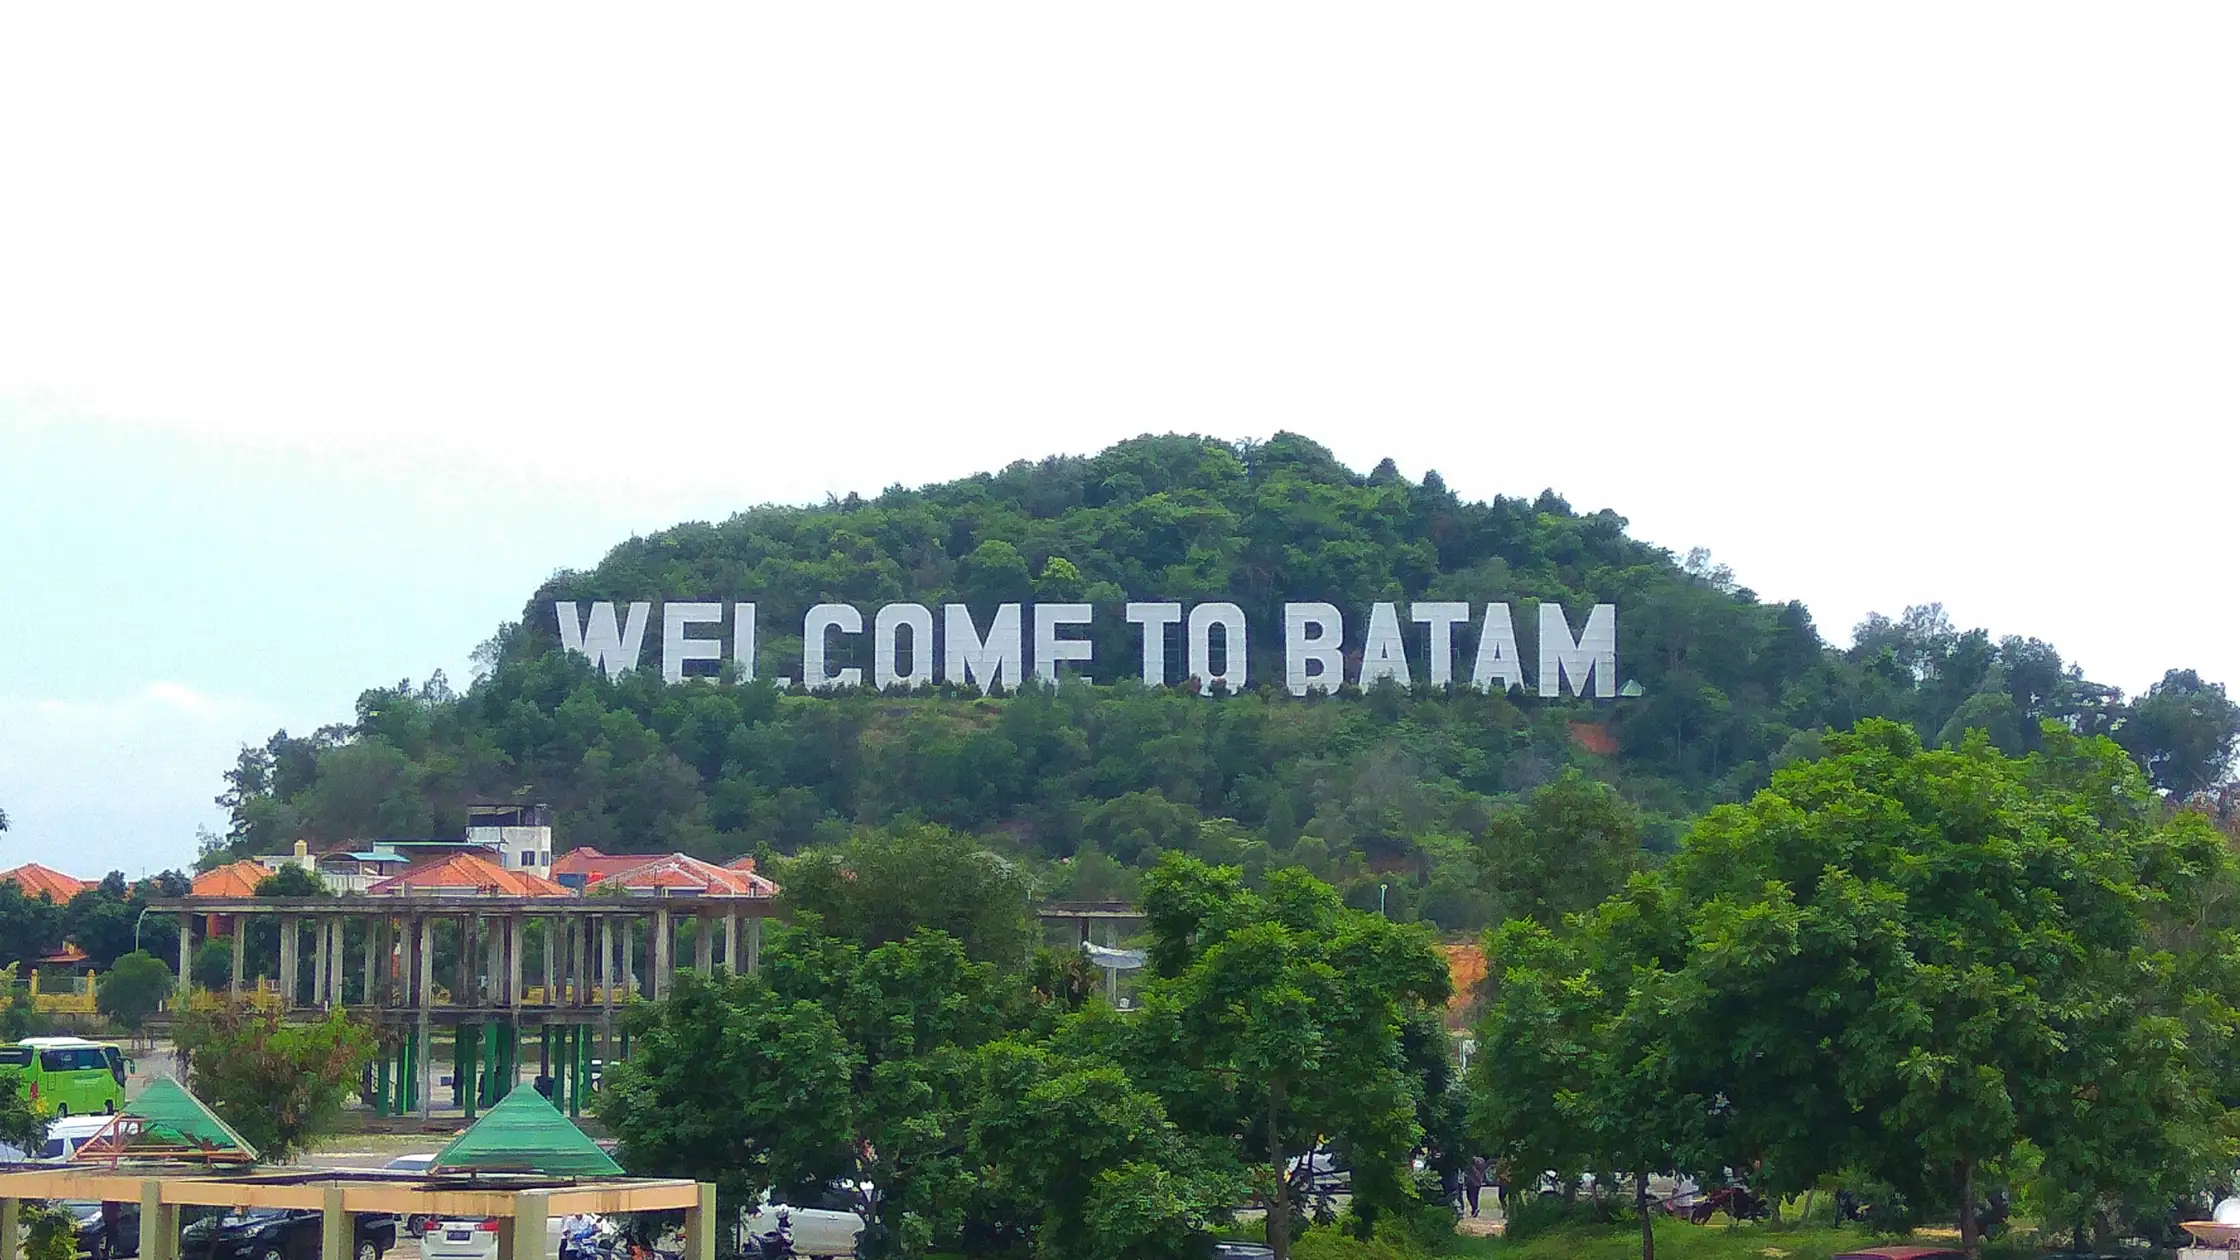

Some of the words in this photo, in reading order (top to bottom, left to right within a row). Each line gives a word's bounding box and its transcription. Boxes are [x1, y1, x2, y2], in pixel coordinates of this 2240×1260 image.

[555, 601, 1093, 696] WELCOME
[1125, 602, 1247, 697] TO
[1284, 602, 1616, 698] BATAM
